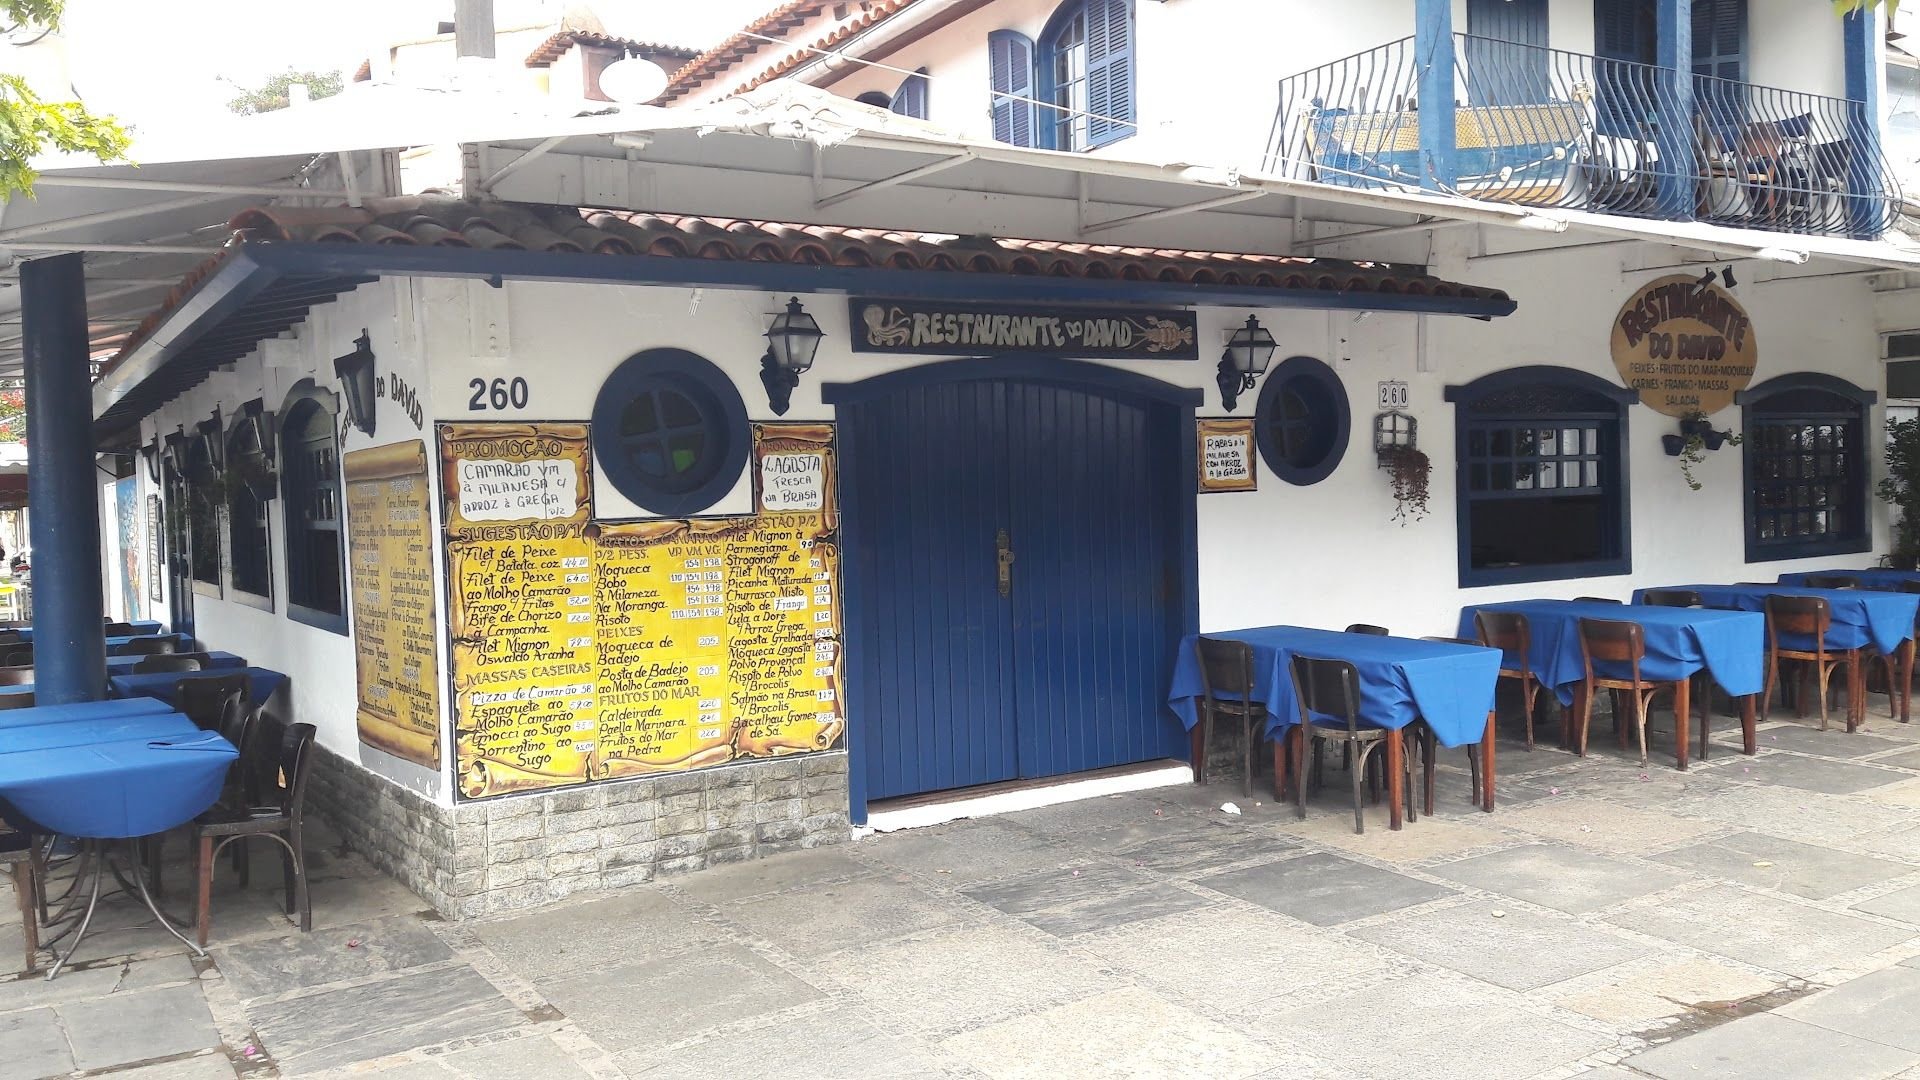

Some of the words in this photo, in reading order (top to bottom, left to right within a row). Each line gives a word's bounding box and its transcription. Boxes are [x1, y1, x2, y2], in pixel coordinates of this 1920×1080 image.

[1620, 282, 1749, 352] RESTAURANTE
[912, 312, 1065, 346] RESTAURANTE
[1065, 320, 1083, 338] DO
[1083, 318, 1132, 347] DAVID
[1649, 333, 1673, 359] DO
[1677, 333, 1726, 360] DAVID
[1630, 362, 1655, 373] PEIXES
[1660, 364, 1686, 375] FRUTOS
[1688, 365, 1699, 375] DO
[1702, 365, 1718, 375] MAR
[1632, 379, 1659, 389] CARNES
[1664, 379, 1693, 389] FRANGO
[1699, 380, 1729, 390] MASSAS
[391, 371, 423, 431] DAVID
[468, 376, 529, 411] 260
[1382, 387, 1407, 403] 260
[1206, 439, 1233, 450] RABAS
[764, 456, 820, 474] LAGOSTA
[1224, 467, 1246, 476] GREGA
[463, 481, 472, 492] à
[479, 478, 548, 496] MILANESA
[772, 475, 812, 488] FRESCA
[463, 500, 498, 514] ARROZ
[504, 498, 511, 508] à
[517, 493, 559, 507] GREGA
[765, 493, 777, 503] NA
[780, 489, 817, 503] BRASA
[798, 515, 819, 527] P/2
[459, 522, 555, 541] SUGESTÃO
[555, 523, 581, 539] P/1
[725, 531, 750, 543] Filet
[752, 529, 792, 543] Mignon
[796, 529, 803, 540] à
[594, 536, 647, 549] PRATOS
[725, 543, 790, 556] Parmegiana
[465, 546, 496, 561] Filet
[501, 546, 516, 559] de
[521, 544, 558, 558] Peixe
[594, 550, 615, 561] P/2
[619, 549, 650, 560] PESS.
[725, 552, 780, 566] Strogonoff
[788, 551, 801, 562] de
[466, 572, 497, 586] Filet
[501, 572, 516, 584] de
[521, 570, 557, 582] Peixe
[595, 562, 651, 578] Moqueca
[728, 566, 752, 579] Filet
[756, 565, 795, 578] Mignon
[467, 591, 483, 600] ao
[483, 585, 520, 600] Molho
[520, 583, 571, 598] Camarão
[596, 578, 628, 590] Bobo
[726, 578, 768, 589] Picanha
[726, 590, 776, 602] Churrasco
[778, 586, 805, 597] Misto
[466, 601, 507, 614] Frango
[521, 597, 555, 610] Fritas
[595, 602, 611, 614] Na
[727, 603, 755, 614] Risoto
[759, 600, 771, 610] de
[468, 612, 496, 627] Bife
[500, 611, 515, 623] de
[518, 609, 562, 622] Chorizo
[595, 613, 631, 627] Risoto
[727, 613, 751, 625] Lula
[762, 610, 787, 621] Doré
[487, 622, 550, 637] Campanha
[596, 626, 644, 639] PEIXES
[745, 624, 774, 634] Arroz
[469, 639, 501, 655] Filet
[505, 638, 550, 653] Mignon
[596, 640, 654, 654] Moqueca
[660, 635, 673, 648] de
[728, 634, 769, 650] Lagosta
[772, 630, 814, 645] Grelhada
[476, 652, 530, 666] Oswaldo
[533, 647, 575, 660] Aranha
[597, 651, 640, 666] Badejo
[728, 647, 775, 660] Moqueca
[777, 642, 811, 656] Lagosta
[728, 659, 757, 670] Polvo
[758, 653, 806, 668] Provençal
[466, 668, 527, 686] MASSAS
[531, 662, 592, 678] CASEIRAS
[598, 668, 632, 681] Posta
[635, 665, 648, 677] de
[648, 661, 689, 678] Badejo
[729, 668, 762, 683] Risoto
[764, 667, 776, 678] de
[778, 665, 803, 678] Polvo
[598, 685, 612, 694] ao
[612, 680, 643, 693] Molho
[645, 676, 690, 689] Camarão
[749, 678, 790, 691] Brocolis
[471, 691, 507, 705] Pizza
[512, 687, 526, 699] de
[528, 684, 577, 699] Camarão
[599, 690, 649, 706] FRUTOS
[652, 689, 668, 701] DO
[671, 686, 701, 699] MAR
[730, 692, 769, 705] Salmão
[471, 700, 540, 719] Espaguete
[548, 700, 564, 709] ao
[599, 705, 663, 722] Caldeirada
[748, 700, 789, 715] Brocolis
[475, 717, 514, 731] Molho
[517, 710, 575, 725] Camarão
[599, 722, 632, 735] Paella
[635, 718, 687, 732] Marinara
[731, 714, 785, 728] Bacalhau
[785, 710, 817, 726] Gomes
[471, 726, 520, 746] Gnocci
[523, 728, 538, 738] ao
[541, 723, 572, 737] Sugo
[600, 733, 635, 748] Frutos
[639, 731, 653, 743] do
[654, 729, 679, 742] Mar
[750, 727, 763, 738] de
[765, 725, 782, 736] Sá.
[477, 739, 546, 756] Sorrentino
[556, 738, 572, 747] ao
[608, 750, 623, 759] na
[627, 744, 662, 757] Pedra
[515, 753, 552, 769] Sugo
